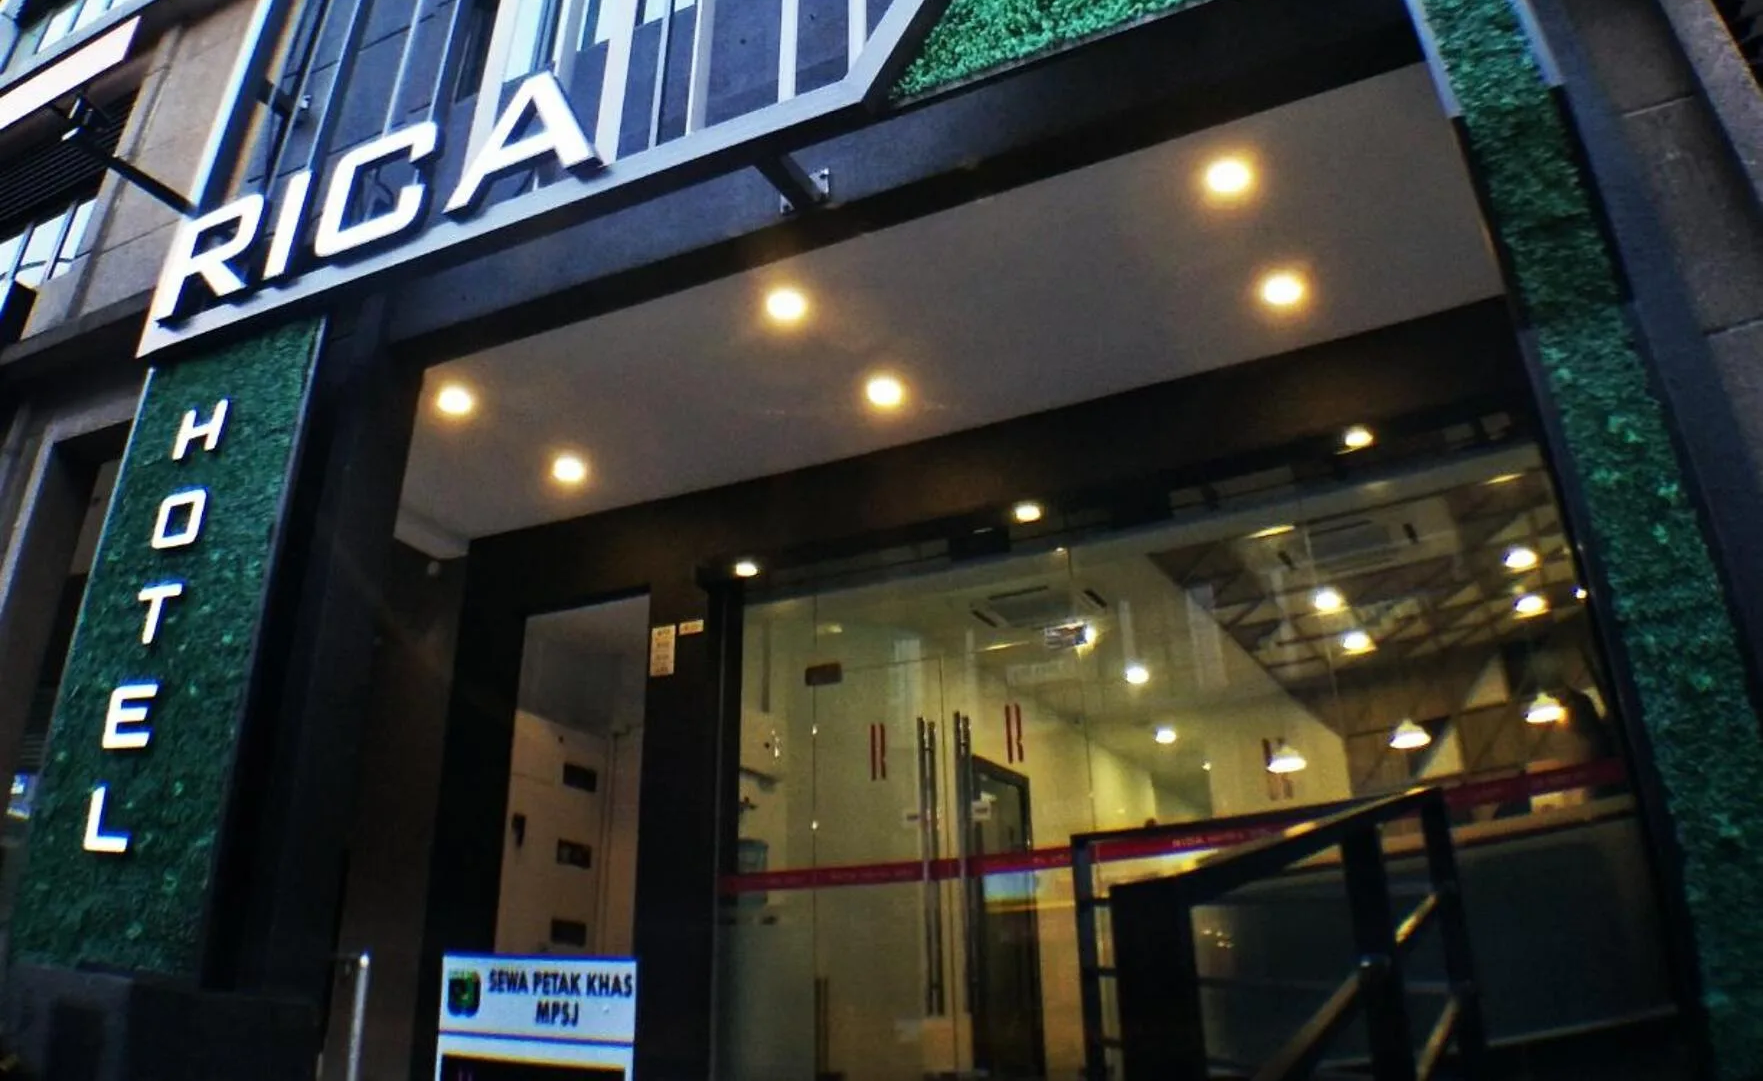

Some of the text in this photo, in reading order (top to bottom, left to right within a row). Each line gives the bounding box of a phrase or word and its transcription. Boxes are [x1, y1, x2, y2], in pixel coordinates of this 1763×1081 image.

[156, 70, 604, 323] RICA
[83, 398, 230, 853] HOTEL
[488, 969, 632, 998] SEWA PETAK KHAS
[535, 1000, 579, 1027] MPSJ
